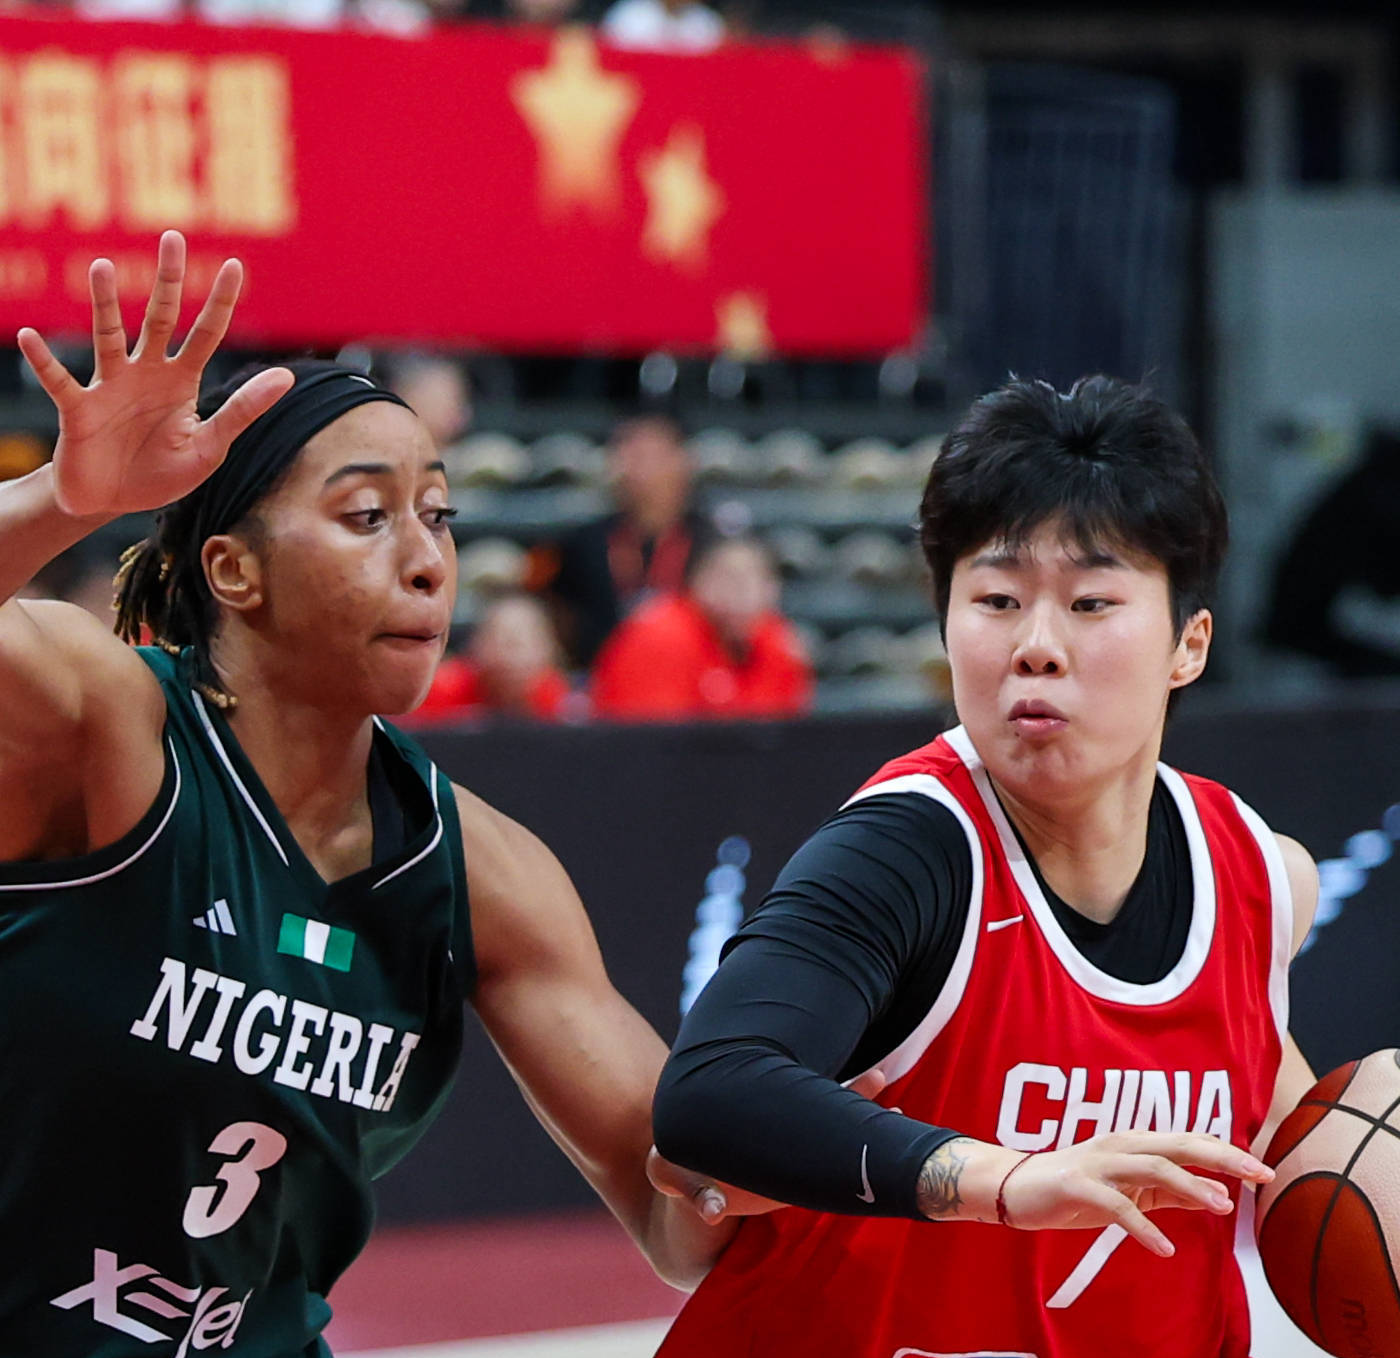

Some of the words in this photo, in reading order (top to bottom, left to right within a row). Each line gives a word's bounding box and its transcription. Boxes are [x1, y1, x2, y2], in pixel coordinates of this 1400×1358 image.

[130, 957, 421, 1112] NIGERIA
[996, 1062, 1233, 1152] CHINA
[182, 1121, 287, 1239] 3
